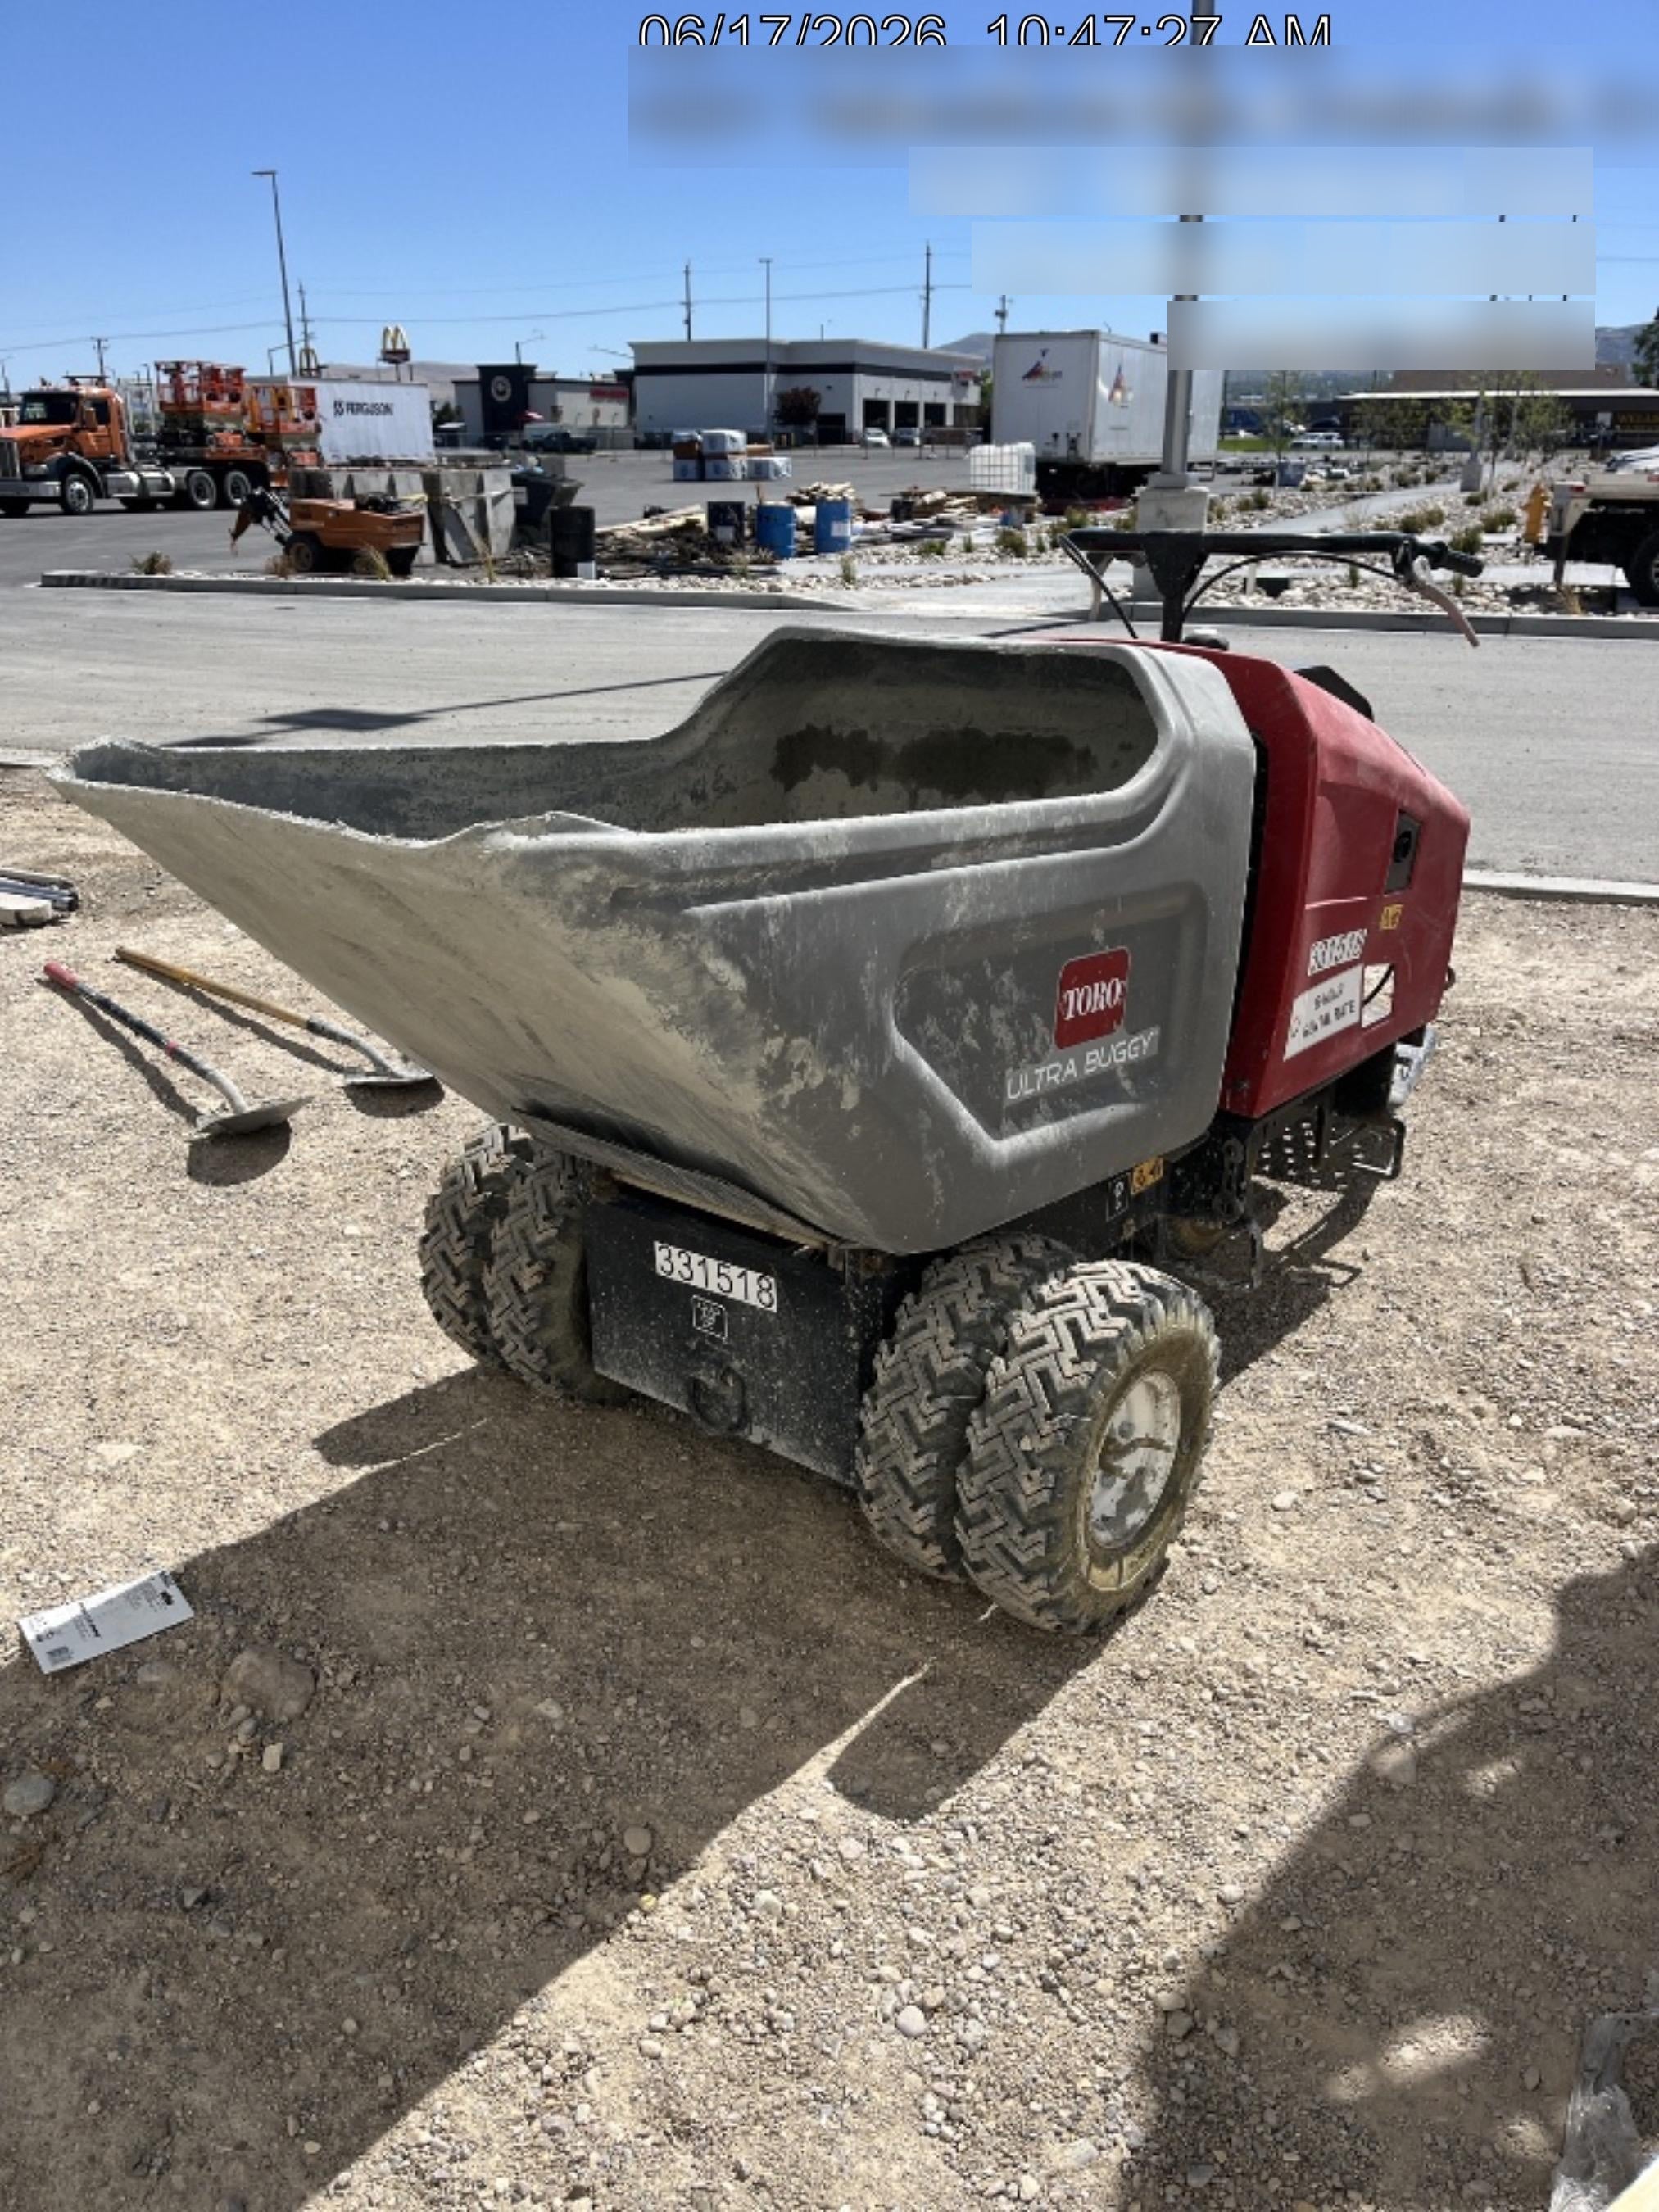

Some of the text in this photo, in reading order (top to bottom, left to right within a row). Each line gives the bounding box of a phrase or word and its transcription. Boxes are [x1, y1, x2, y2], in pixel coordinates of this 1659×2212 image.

[1064, 977, 1123, 1022] TORO
[1006, 1031, 1156, 1099] ULTRA BUGGY
[658, 1245, 774, 1308] 331518
